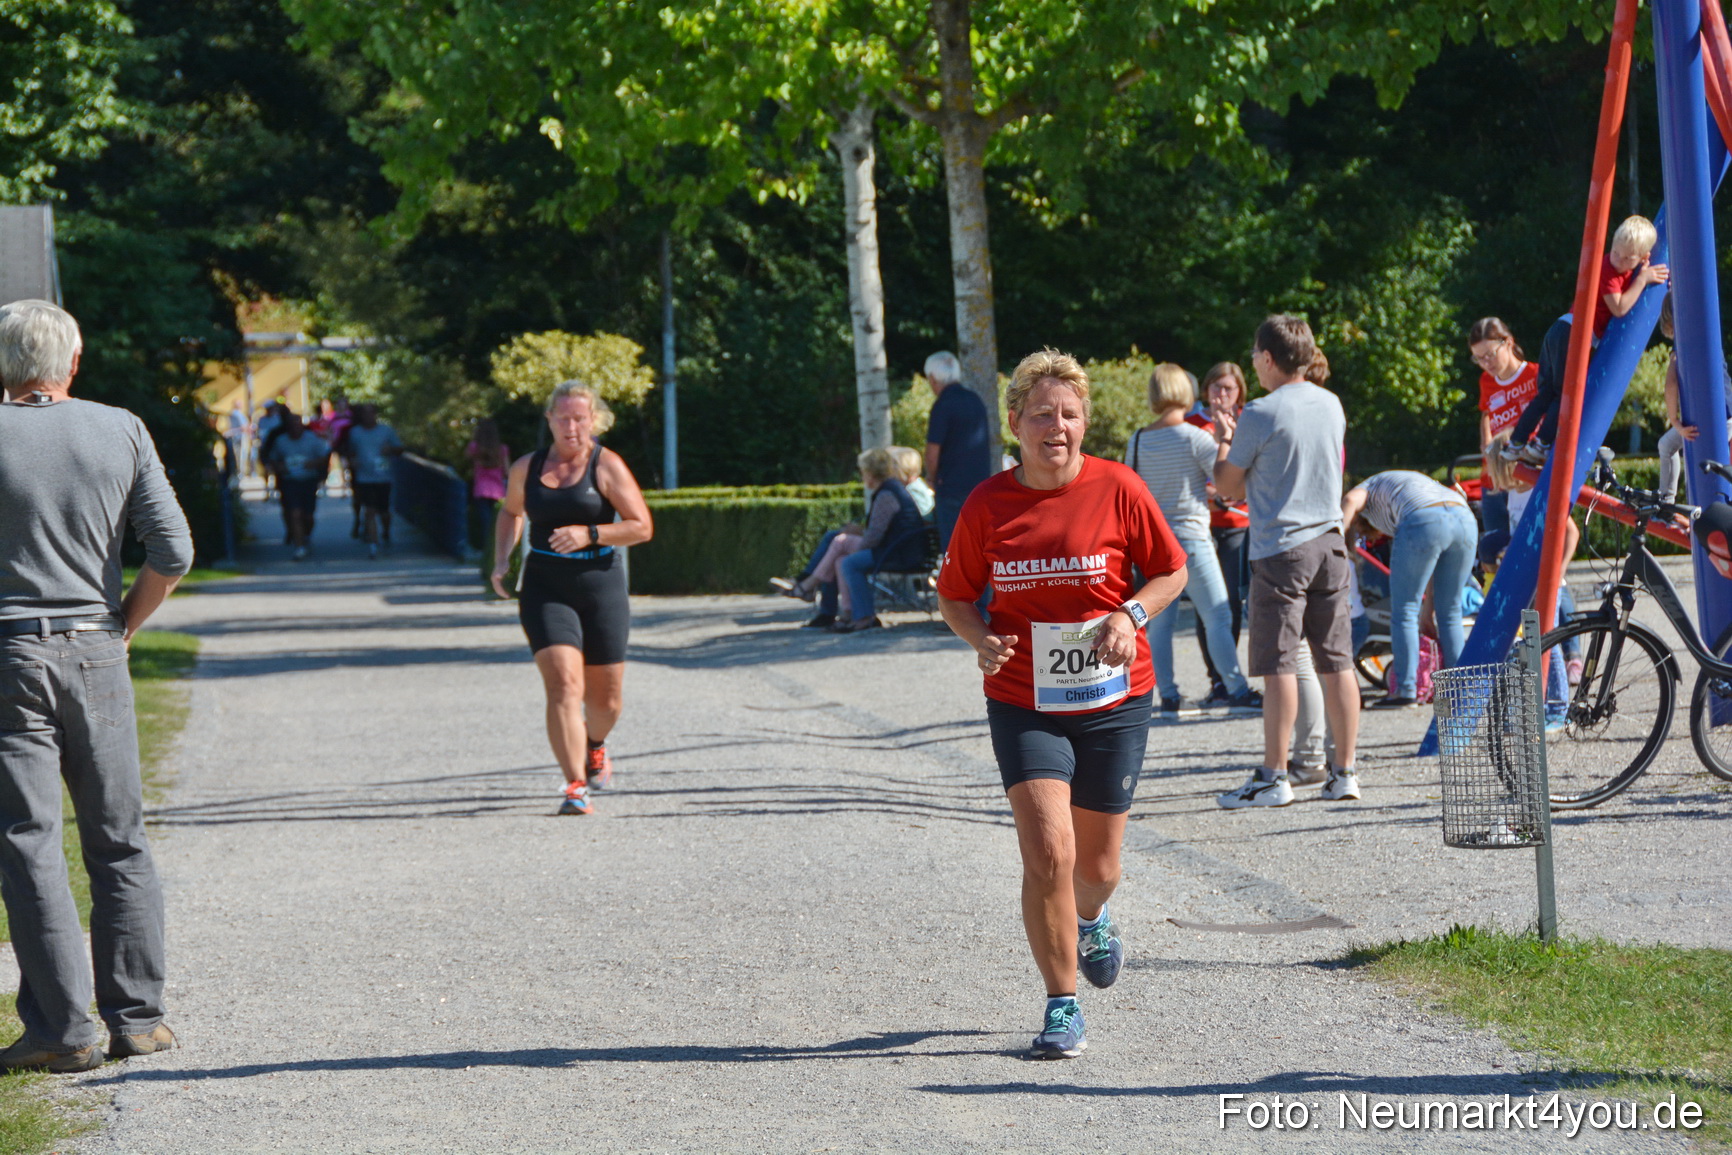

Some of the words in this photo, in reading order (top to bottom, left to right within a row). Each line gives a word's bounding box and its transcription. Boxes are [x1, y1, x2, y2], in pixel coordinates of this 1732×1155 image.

[993, 553, 1106, 576] FACKELMANN
[1047, 578, 1080, 587] KÜCHE
[1089, 575, 1106, 585] BAD
[1078, 673, 1106, 684] Neumarkt
[1065, 687, 1106, 701] Christa
